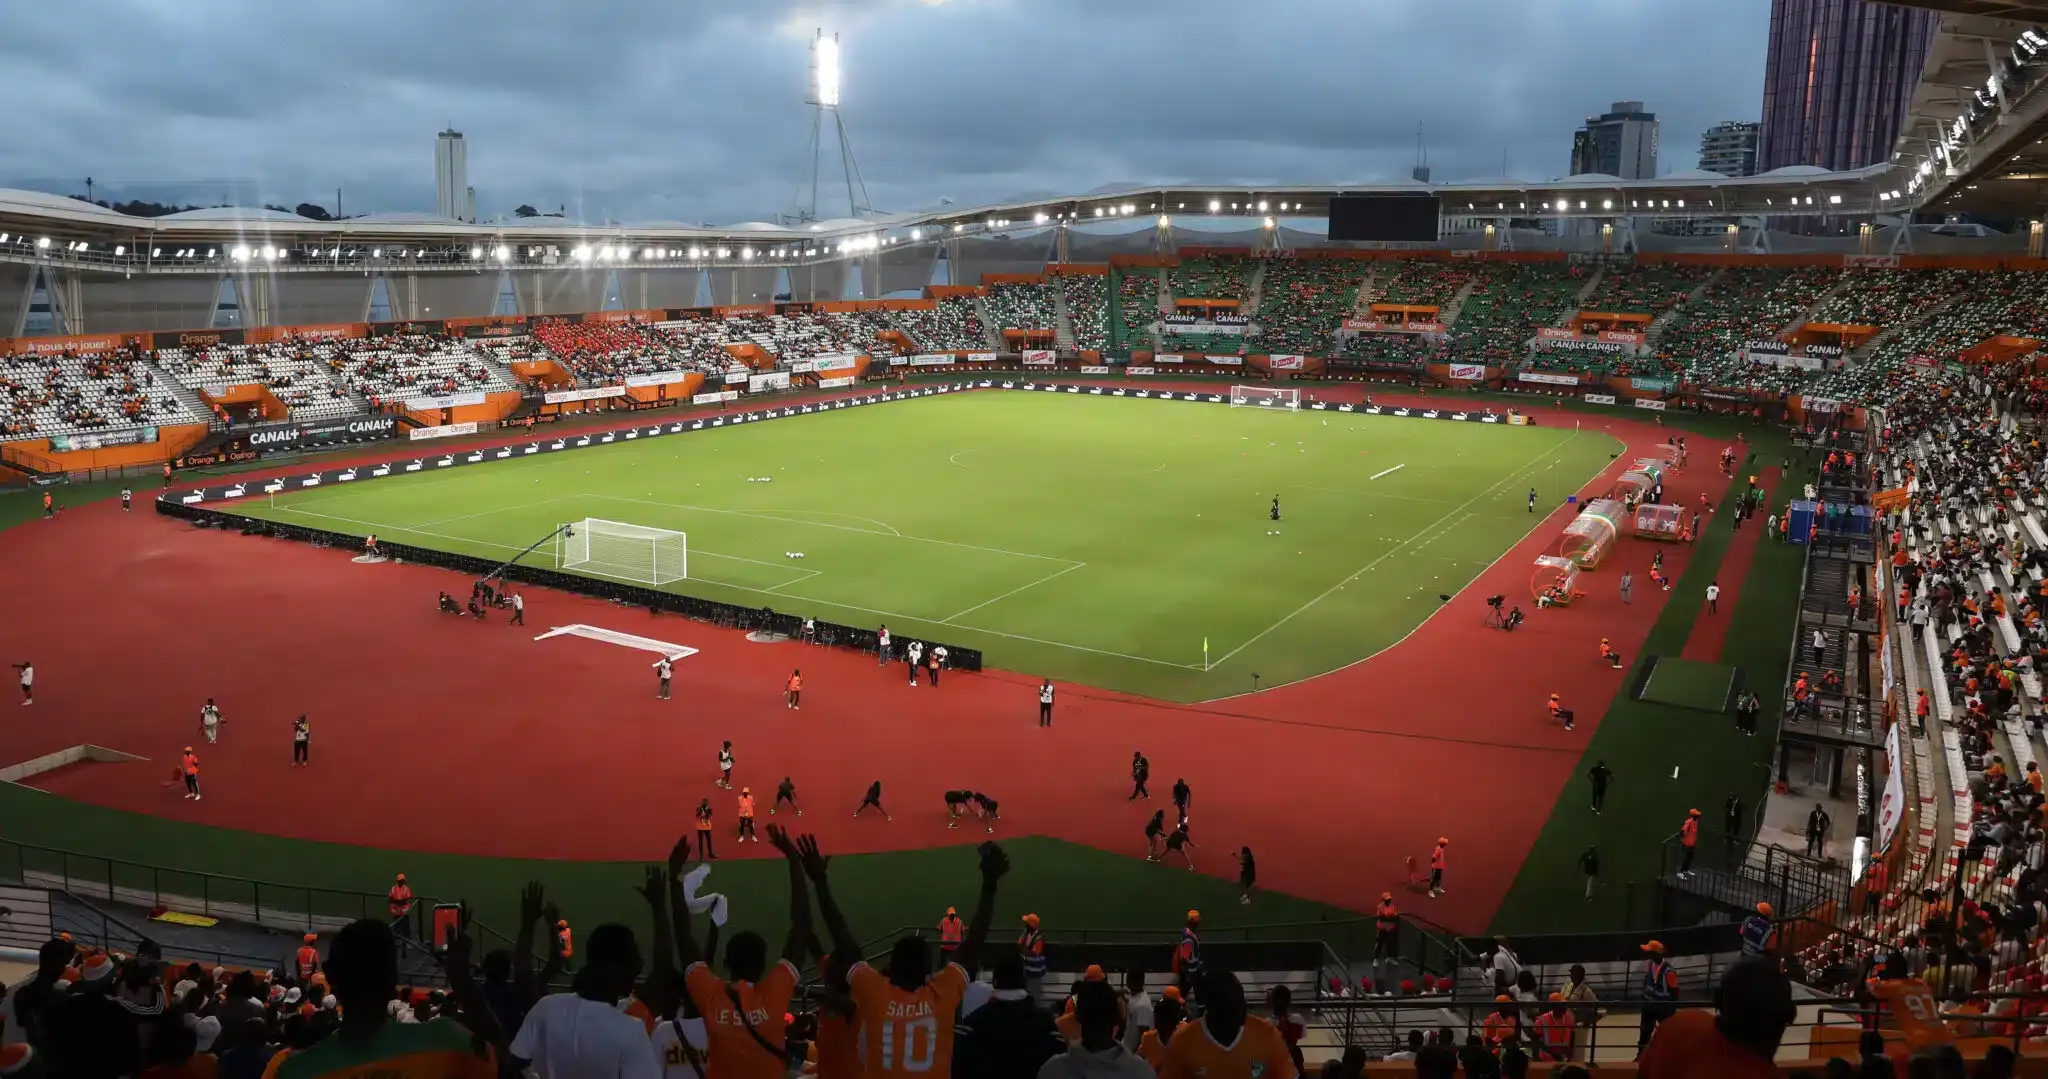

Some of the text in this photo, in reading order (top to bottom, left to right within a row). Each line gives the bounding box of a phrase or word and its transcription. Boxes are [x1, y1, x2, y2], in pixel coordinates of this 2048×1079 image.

[1165, 314, 1195, 322] CANAL+
[1216, 315, 1248, 323] CANAL+
[1348, 320, 1377, 329] Orange
[1408, 322, 1437, 331] Orange
[1544, 328, 1573, 338] Orange
[1607, 331, 1637, 341] Orange
[179, 333, 221, 346] Orange
[27, 341, 36, 351] À
[38, 343, 63, 352] nous
[65, 340, 78, 350] de
[80, 340, 105, 351] jouer
[1550, 340, 1621, 351] CANAL+ CANAL+
[1751, 340, 1788, 351] CANAL+
[1806, 344, 1842, 355] CANAL+
[350, 417, 394, 433] CANAL+
[412, 423, 475, 438] Orange Orange
[250, 427, 300, 446] CANAL+
[187, 455, 216, 466] Orange
[716, 1007, 730, 1024] LE
[882, 1016, 937, 1072] 10
